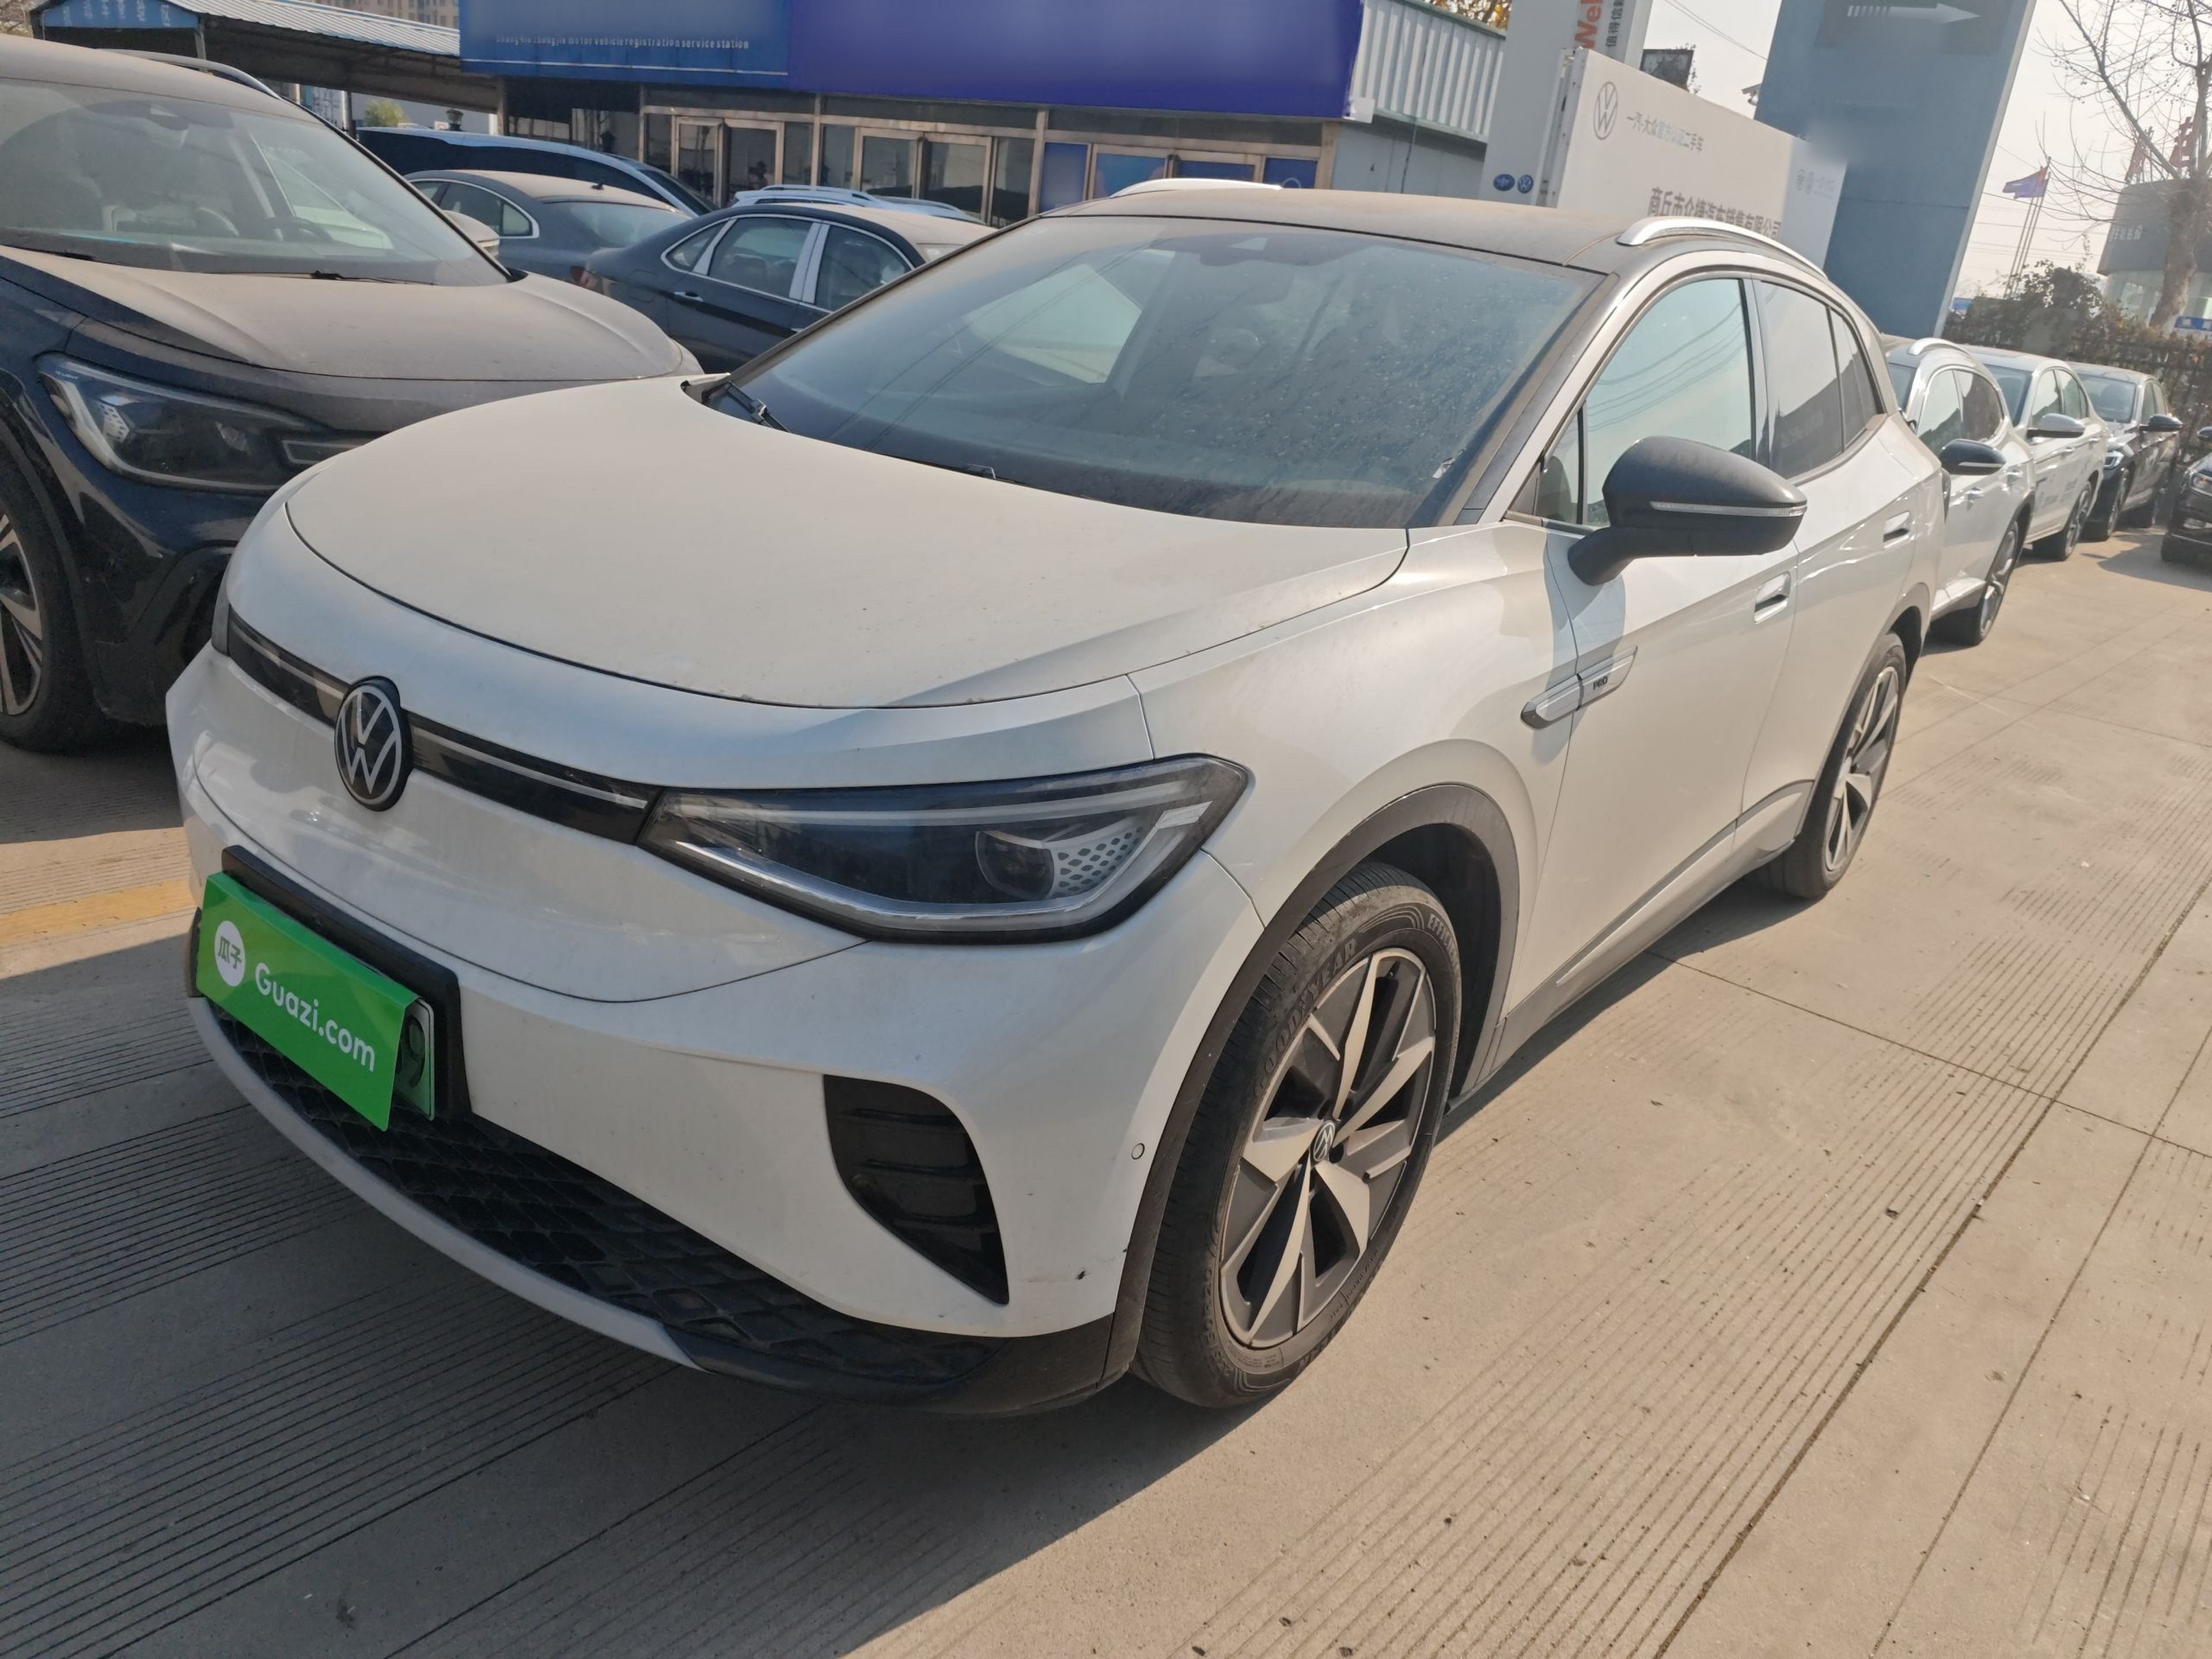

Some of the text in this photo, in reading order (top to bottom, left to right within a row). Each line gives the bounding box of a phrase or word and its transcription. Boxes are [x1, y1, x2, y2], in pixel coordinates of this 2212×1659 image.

[568, 36, 592, 45] motor
[594, 36, 623, 46] vehicle
[624, 36, 680, 48] registration
[681, 38, 714, 48] service
[716, 38, 749, 49] station
[1593, 676, 1608, 690] PRO
[218, 935, 243, 970] 瓜子
[255, 962, 376, 1073] Guazi.com
[1253, 937, 1357, 1097] GOODYEAR
